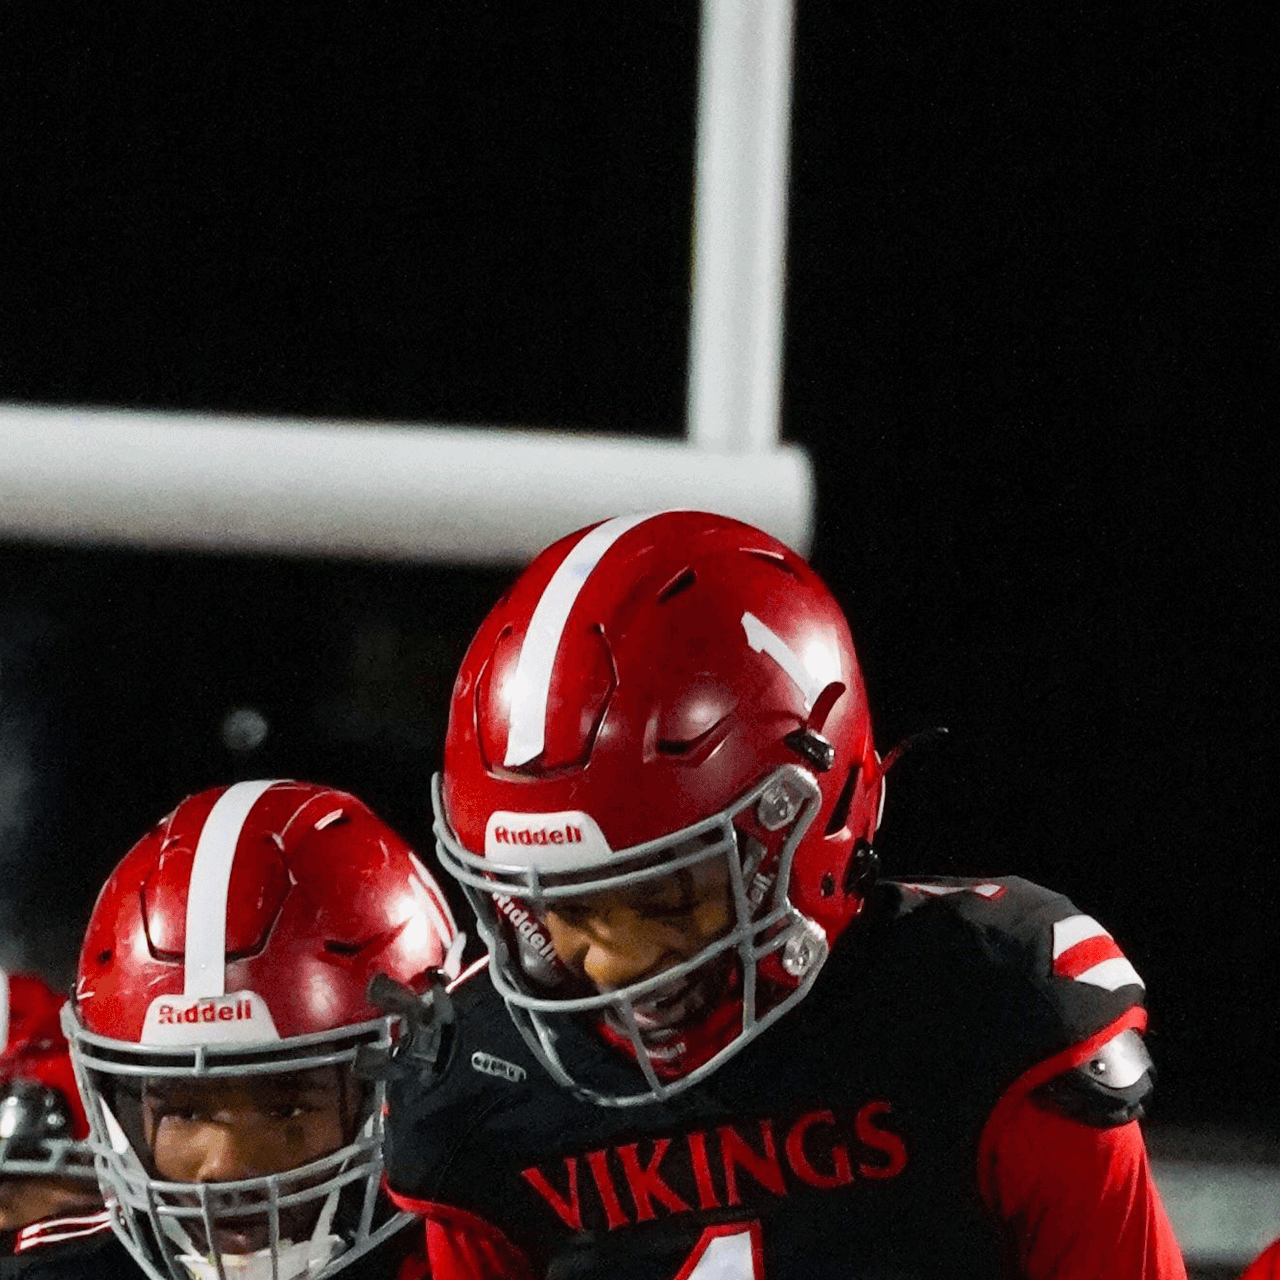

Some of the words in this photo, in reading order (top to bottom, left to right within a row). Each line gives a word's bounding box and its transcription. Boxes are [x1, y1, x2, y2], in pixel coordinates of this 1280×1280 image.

[494, 823, 583, 846] Riddell
[158, 999, 252, 1024] Riddell
[520, 1099, 908, 1232] VIKINGS
